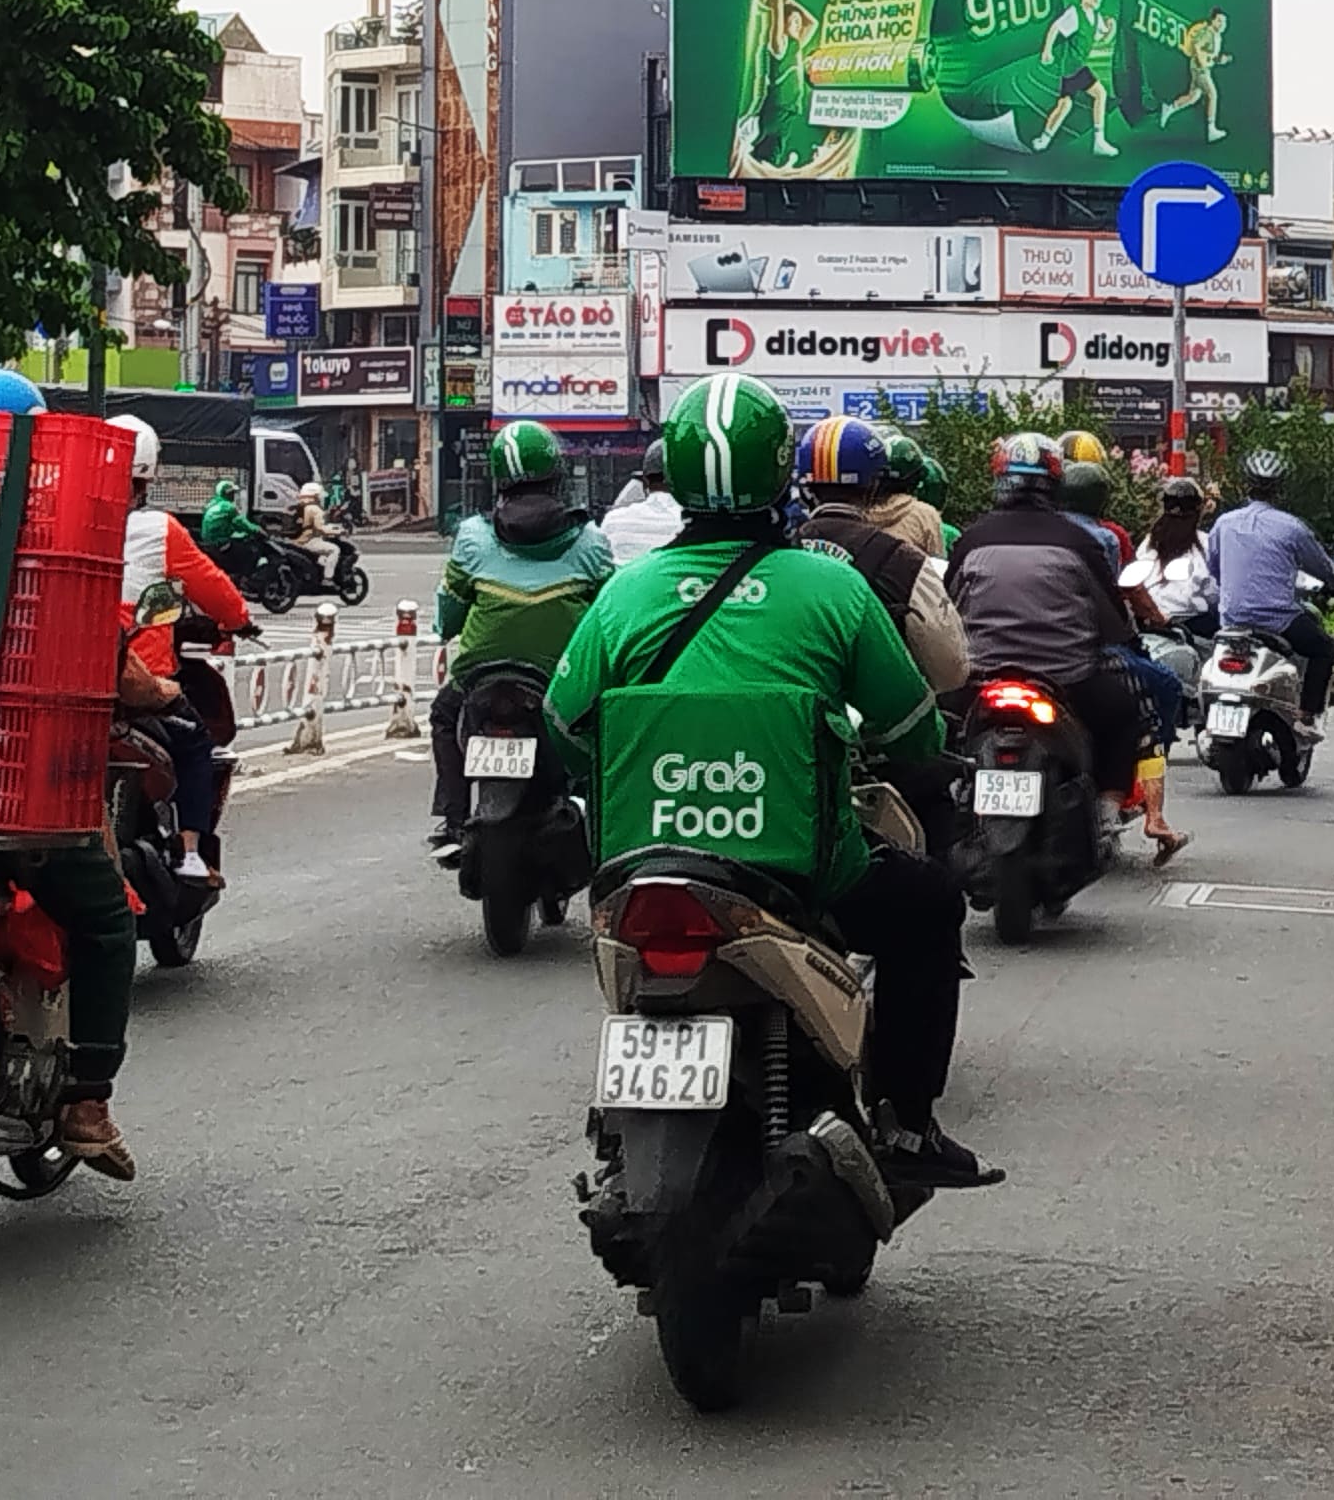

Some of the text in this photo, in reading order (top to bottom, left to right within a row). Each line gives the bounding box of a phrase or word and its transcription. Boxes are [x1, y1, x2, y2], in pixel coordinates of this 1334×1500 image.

[824, 20, 914, 43] KHOA HỌC
[1022, 249, 1051, 264] THU
[528, 300, 615, 327] TÁO ĐỎ
[1084, 333, 1232, 368] didongiet.vn
[304, 356, 351, 377] tokuyo
[502, 375, 619, 396] mobifone
[652, 750, 766, 793] Grab
[652, 796, 764, 840] Food
[621, 1023, 709, 1061] 59-P1
[606, 1063, 721, 1102] 346.20
